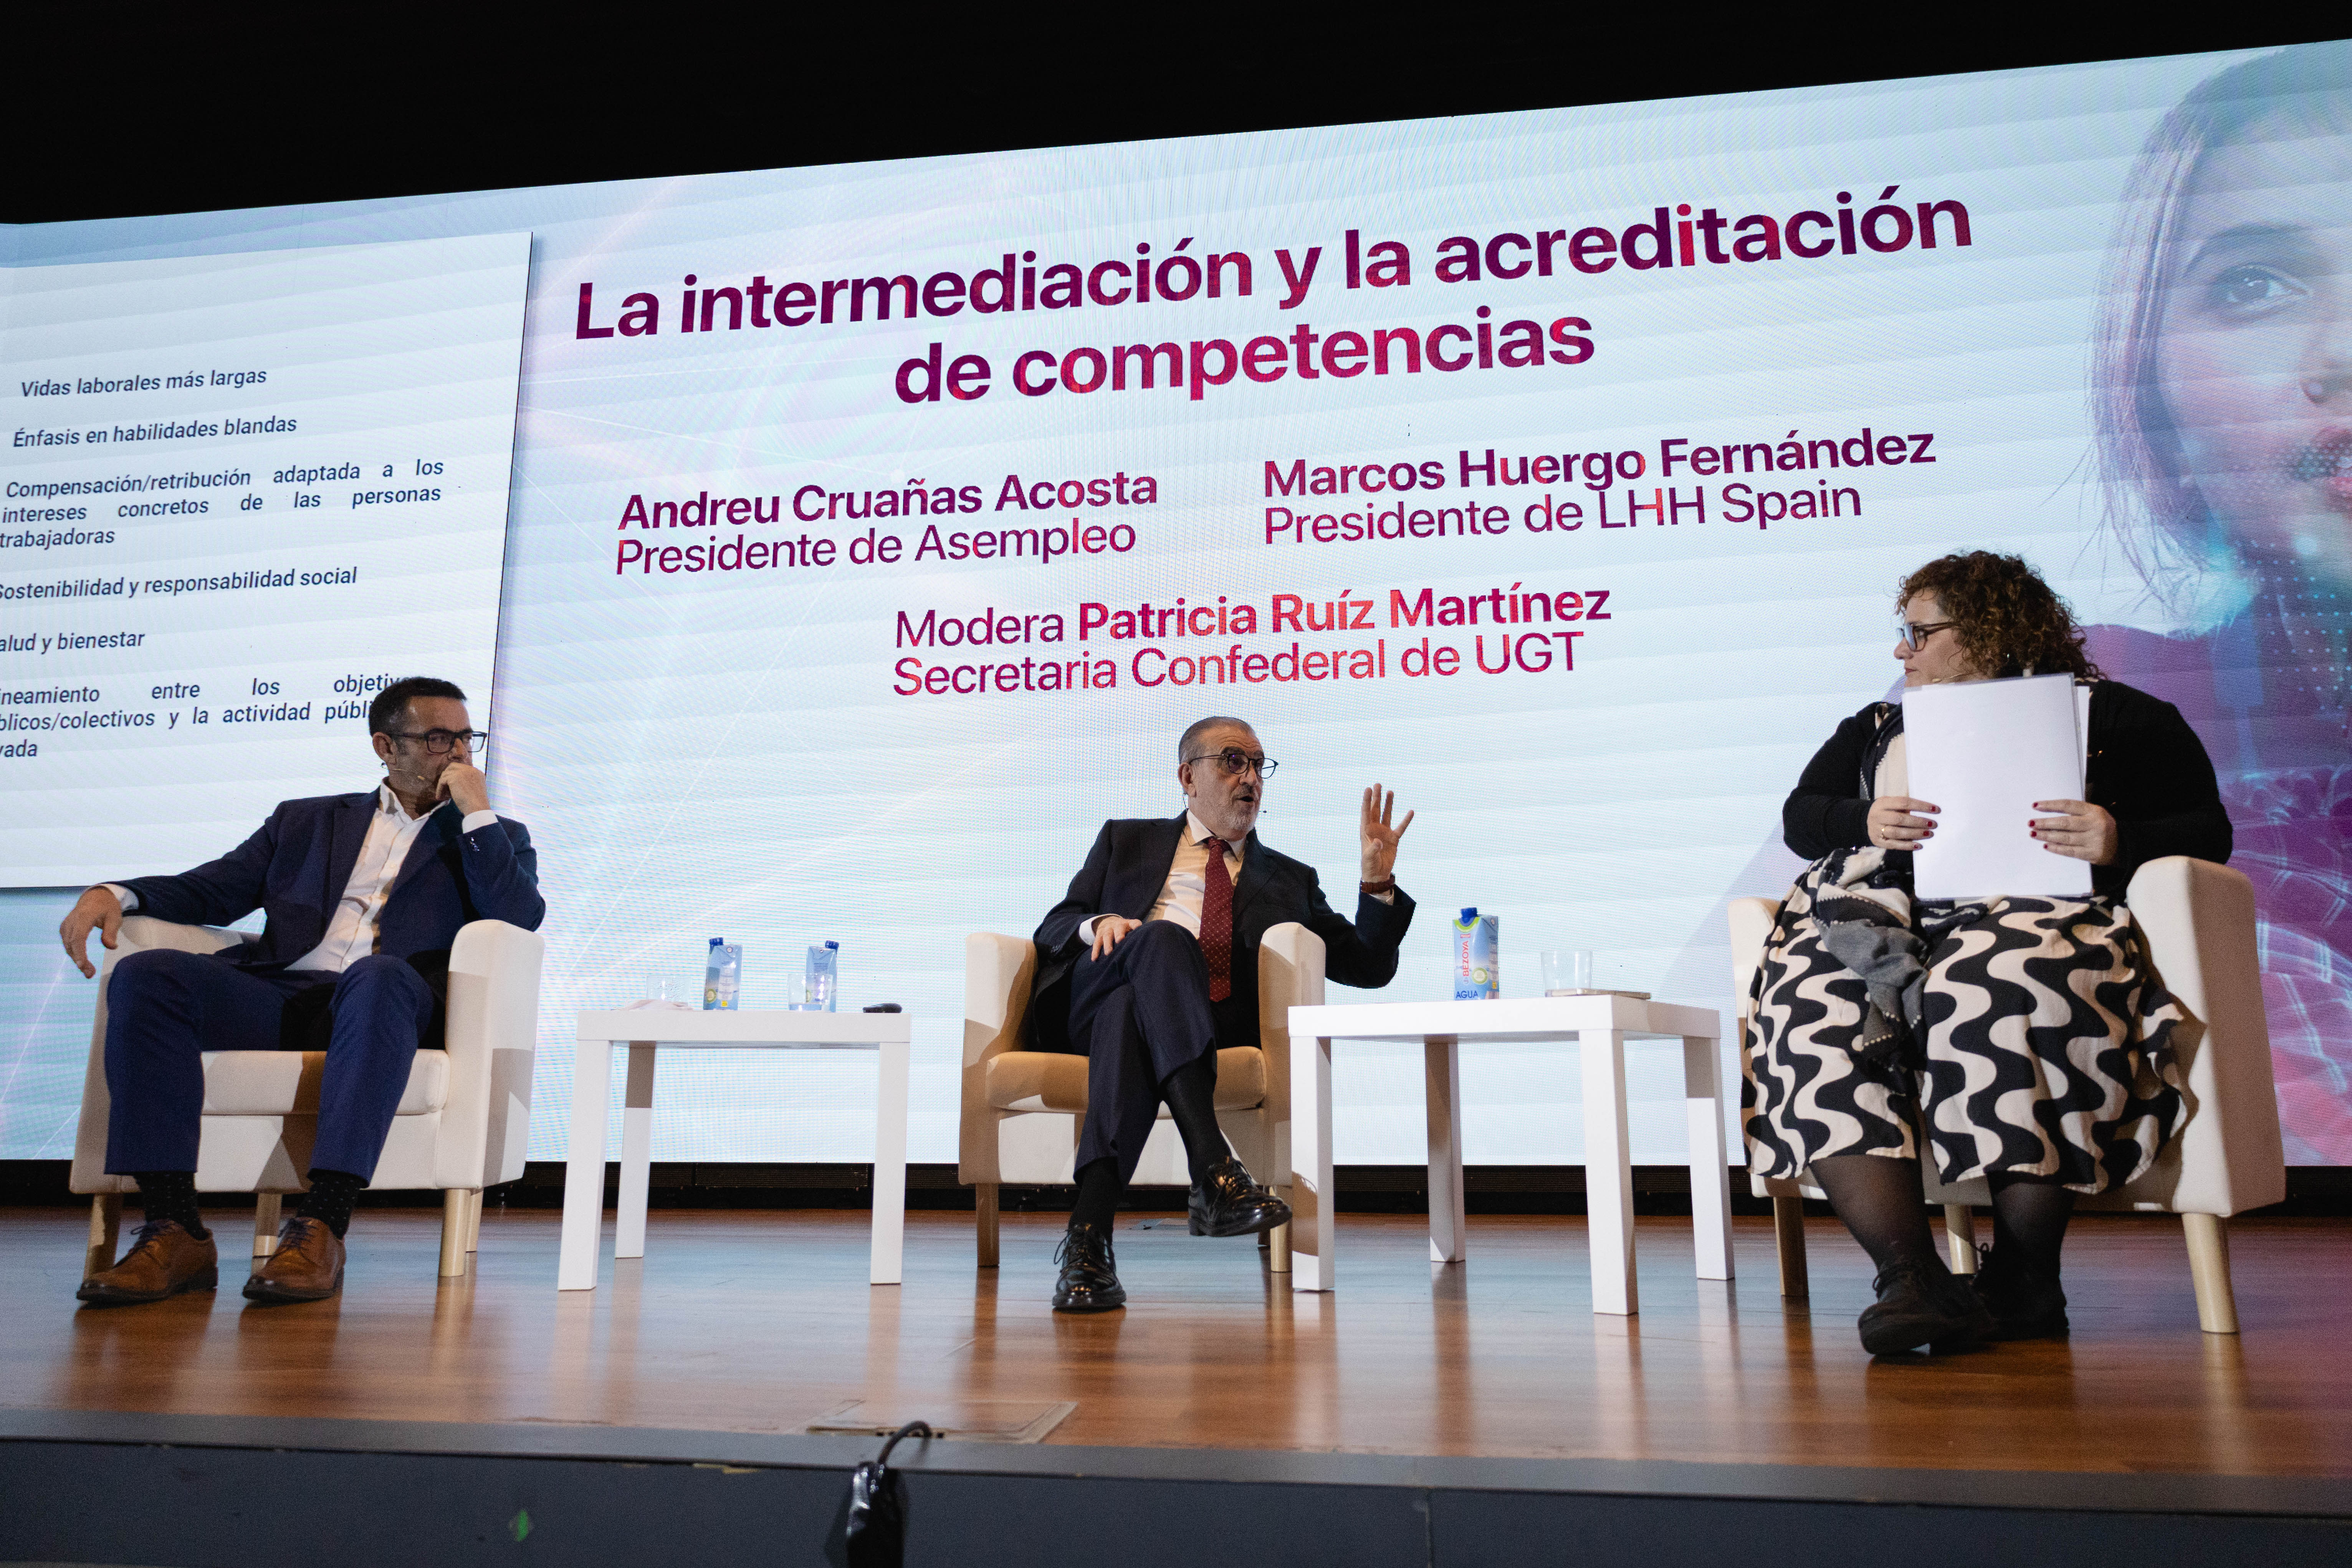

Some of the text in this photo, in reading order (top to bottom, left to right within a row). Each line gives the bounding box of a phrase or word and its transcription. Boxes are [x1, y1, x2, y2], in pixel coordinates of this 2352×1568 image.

[576, 185, 1972, 339] La intermediación y la acreditación
[895, 305, 1594, 404] de competencias
[22, 370, 266, 397] Vidas laborales más largas
[14, 416, 296, 447] Énfasis en habilidades blandas
[7, 459, 443, 499] Compensación/retribución adaptada a los
[1265, 428, 1936, 497] Marcos Huergo Fernández
[3, 489, 440, 523] intereses concretos de las personas
[619, 472, 1157, 530] Andreu Cruañas Acosta
[1266, 483, 1861, 544] Presidente de LHH Spain
[0, 528, 114, 550] trabajadoras
[617, 518, 1136, 575] Presidente de Asempleo
[129, 582, 139, 598] y
[145, 569, 294, 595] responsabilidad
[301, 567, 357, 585] social
[896, 582, 1611, 648] Modera Patricia Ruíz Martínez
[0, 632, 145, 654] alud y bienestar
[894, 631, 1584, 696] Secretaria Confederal de UGT
[0, 687, 99, 705] neamiento
[152, 683, 199, 699] entre
[253, 678, 279, 695] los
[0, 710, 154, 731] blicos/colectivos
[169, 713, 179, 729] y
[193, 707, 208, 724] la
[223, 702, 310, 722] actividad
[1456, 990, 1479, 999] AGUA
